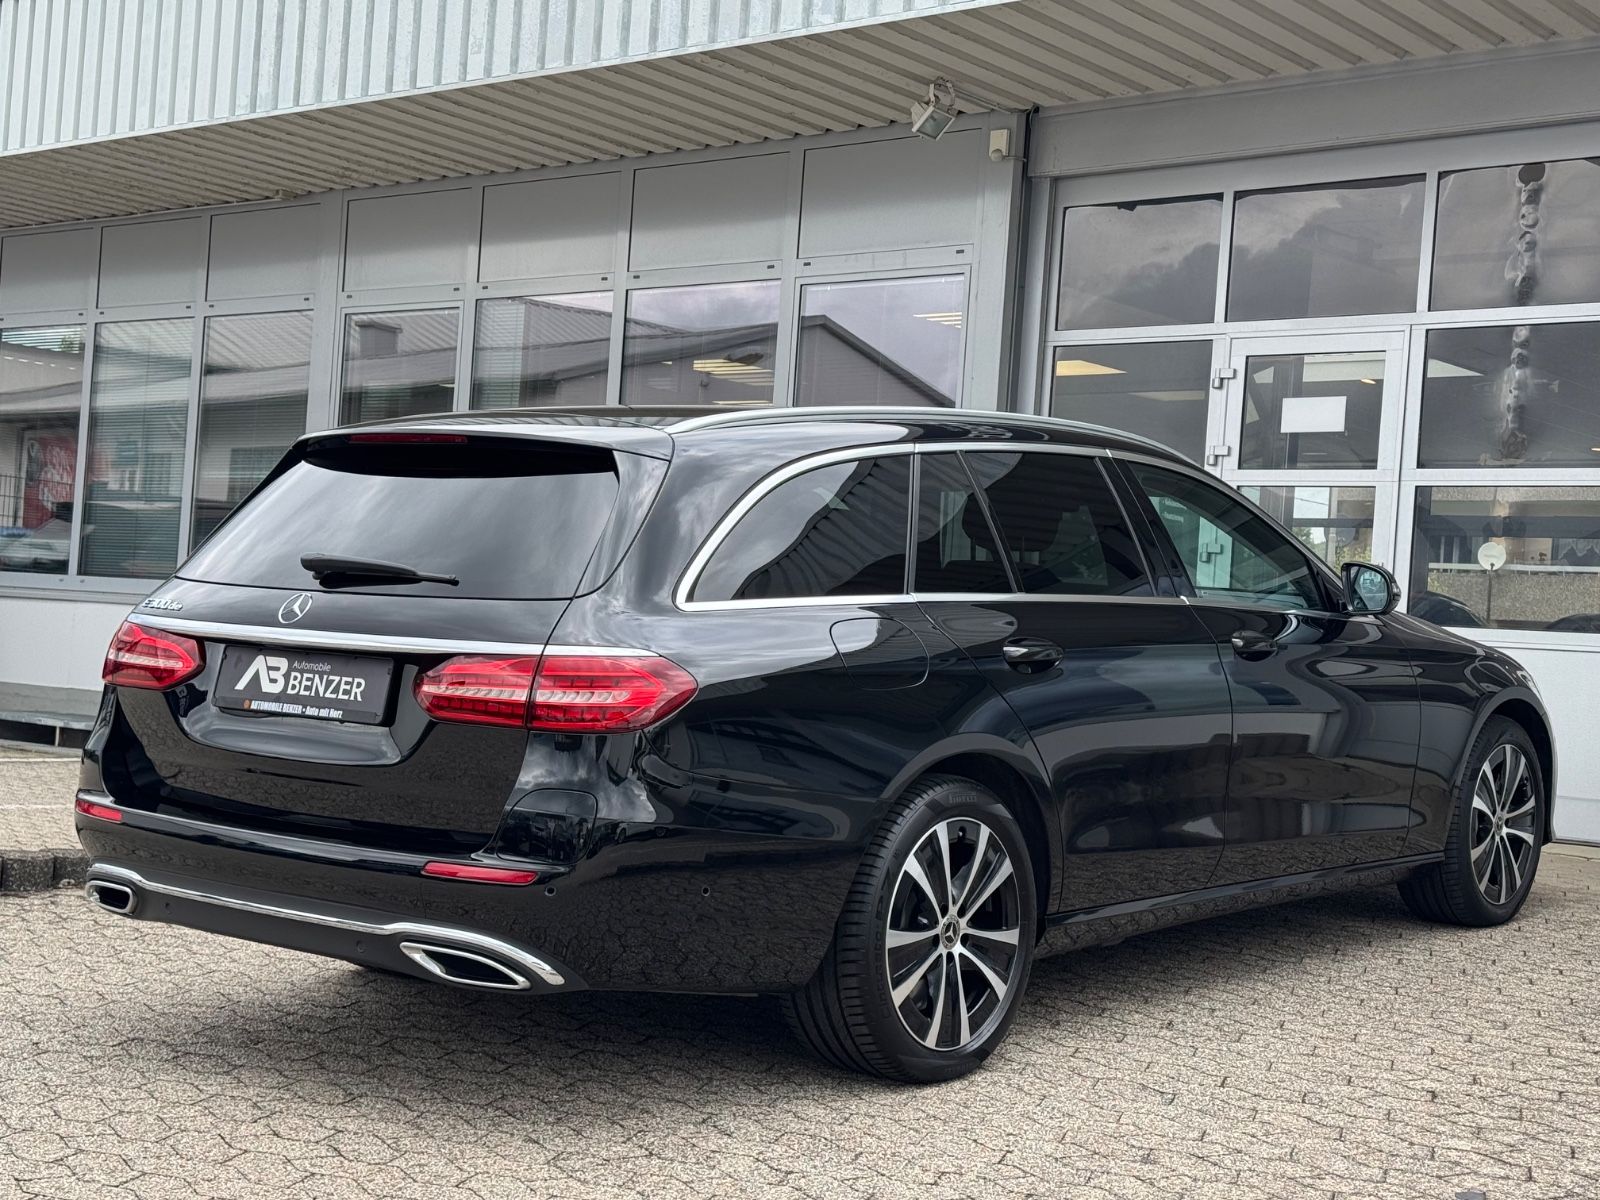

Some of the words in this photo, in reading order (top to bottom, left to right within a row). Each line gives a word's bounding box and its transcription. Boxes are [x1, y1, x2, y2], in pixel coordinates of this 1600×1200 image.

[292, 660, 332, 672] Automobile
[286, 672, 366, 702] BENZER
[251, 700, 283, 712] AUTOMOBILE
[283, 703, 303, 714] BENZER
[305, 706, 319, 716] Auto
[319, 708, 329, 717] mit
[329, 708, 343, 718] Herz
